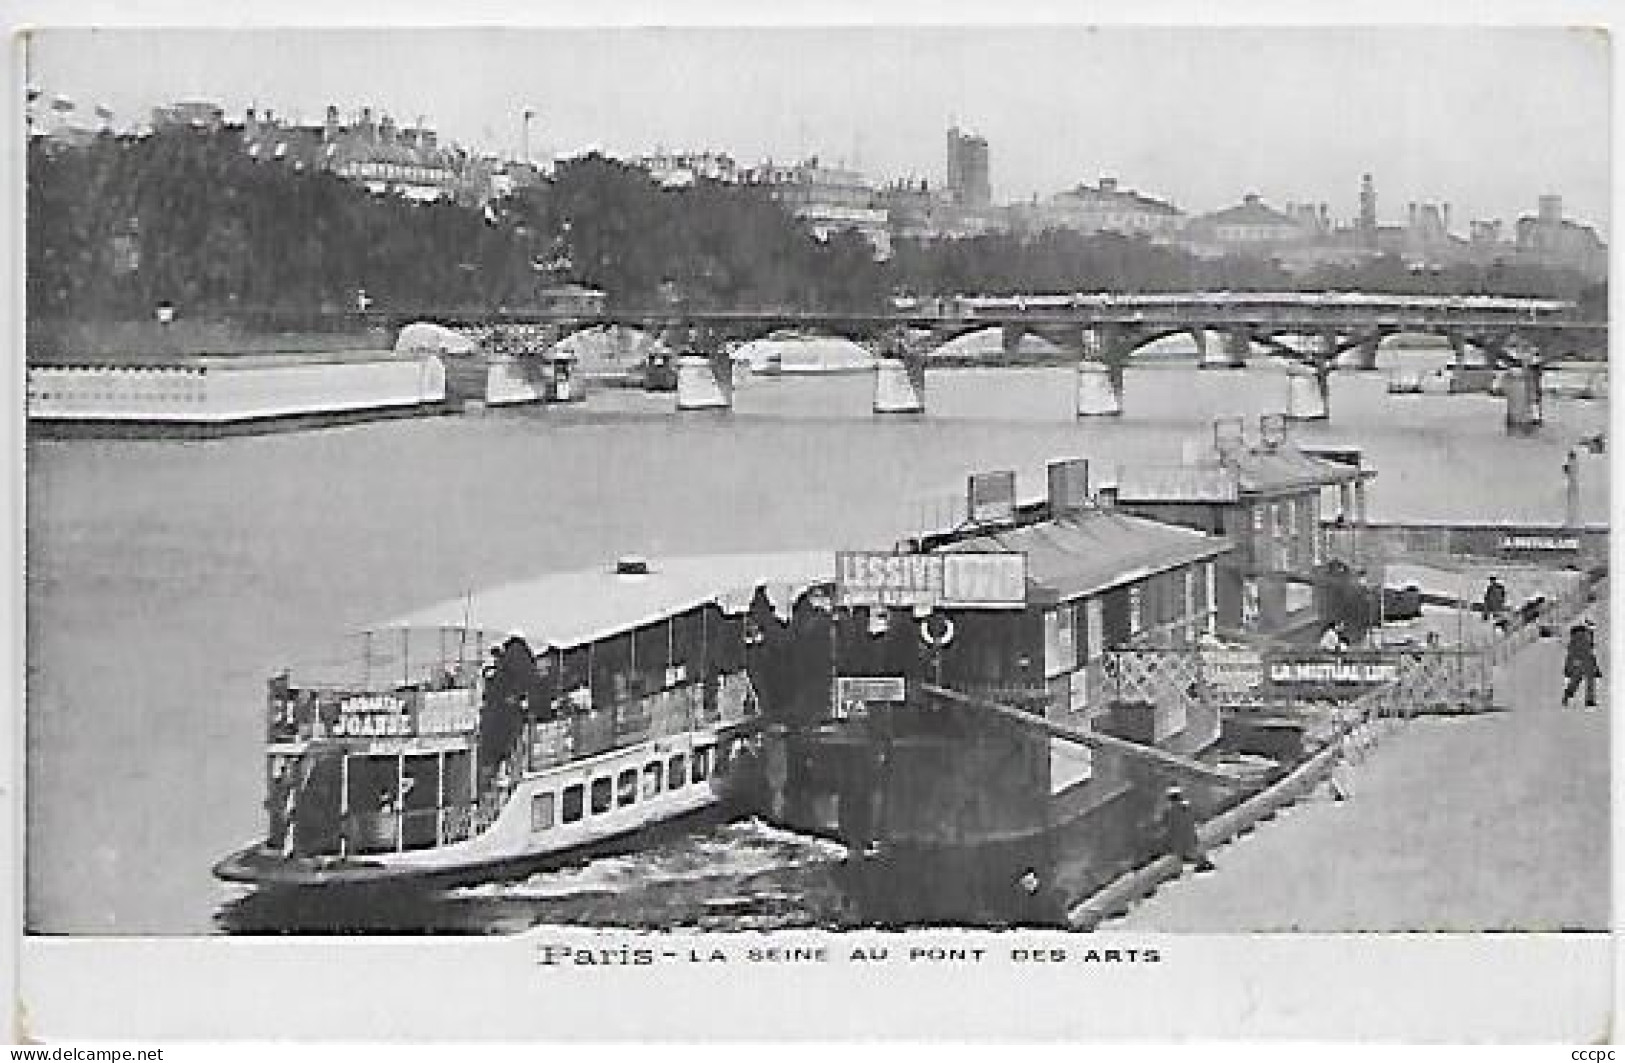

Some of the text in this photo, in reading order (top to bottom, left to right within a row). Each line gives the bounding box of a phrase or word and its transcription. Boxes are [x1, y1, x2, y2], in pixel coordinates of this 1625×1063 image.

[843, 555, 942, 588] LESSIVE
[537, 944, 653, 965] Paris
[688, 949, 727, 963] LA
[747, 948, 831, 963] SEINE
[849, 948, 888, 963] AU
[909, 948, 987, 963] PONT
[1010, 949, 1067, 963] DES
[1084, 949, 1162, 963] ARTS
